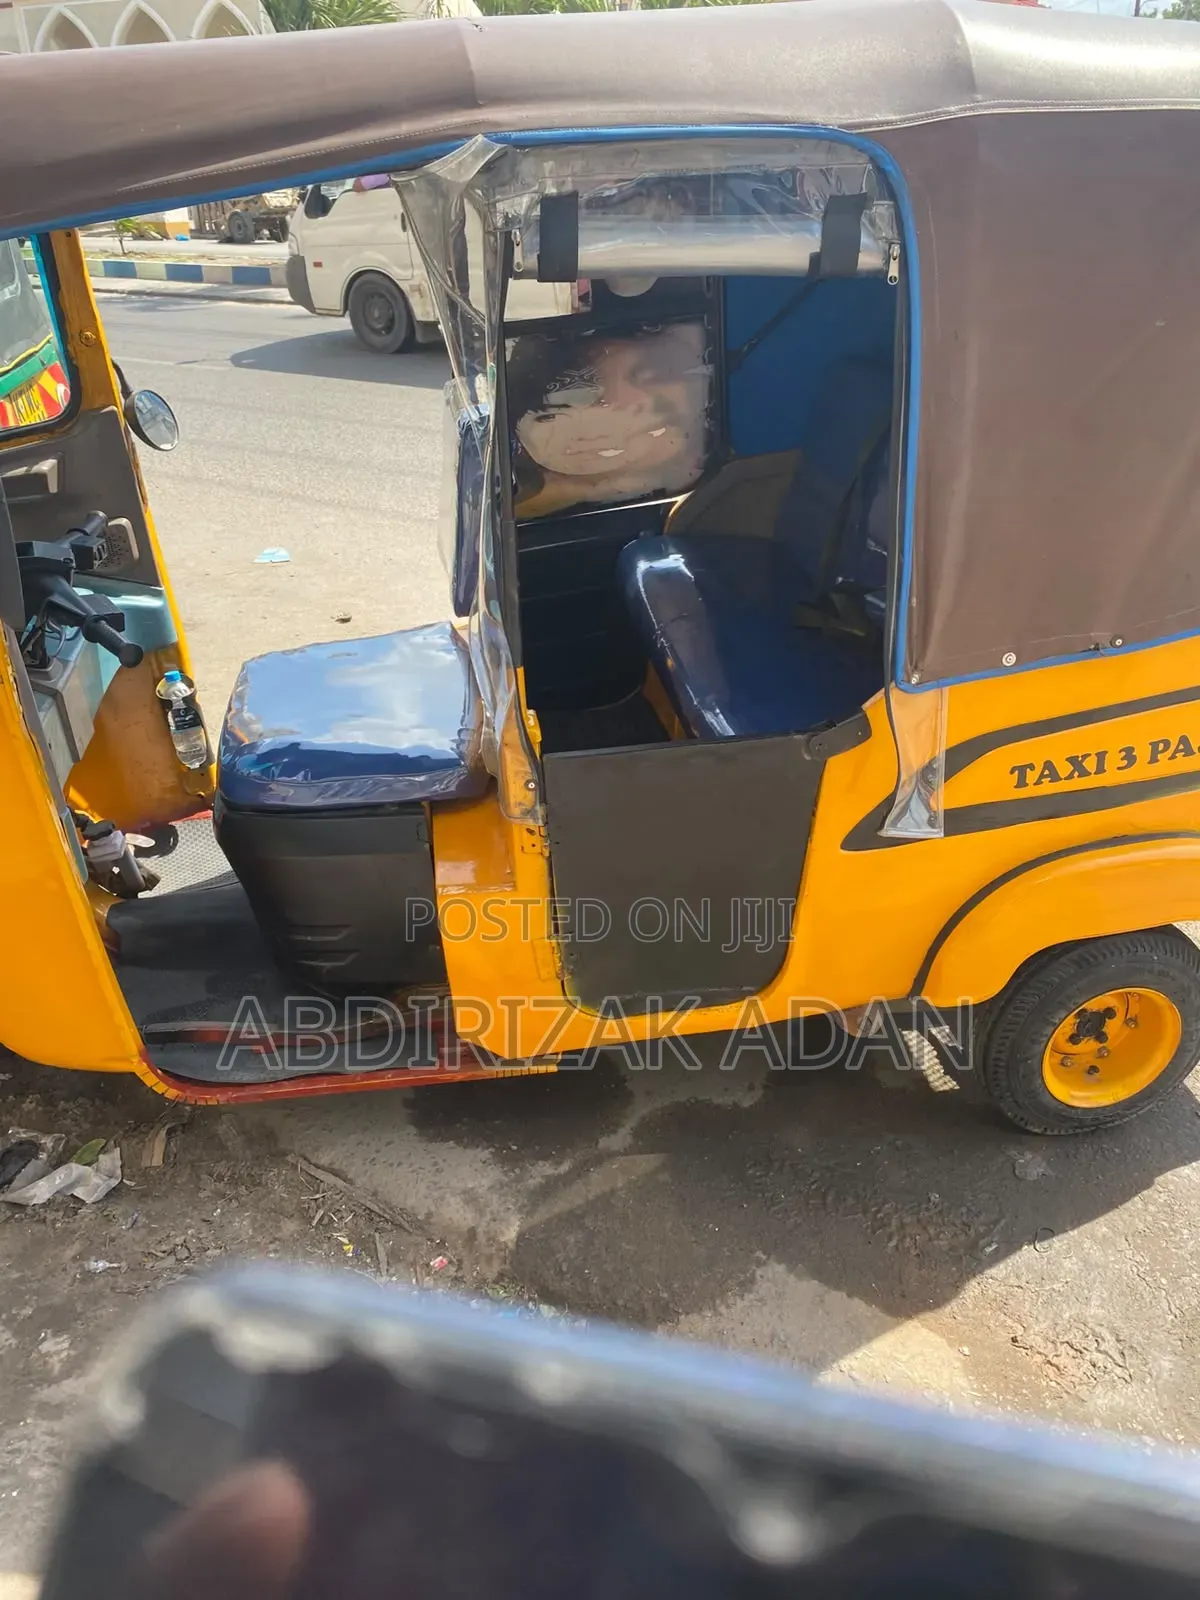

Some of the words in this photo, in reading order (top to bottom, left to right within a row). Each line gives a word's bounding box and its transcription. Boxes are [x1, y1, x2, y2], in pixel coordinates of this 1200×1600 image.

[1009, 750, 1109, 789] TAXI
[1116, 746, 1138, 771] 3
[1147, 734, 1200, 764] PA
